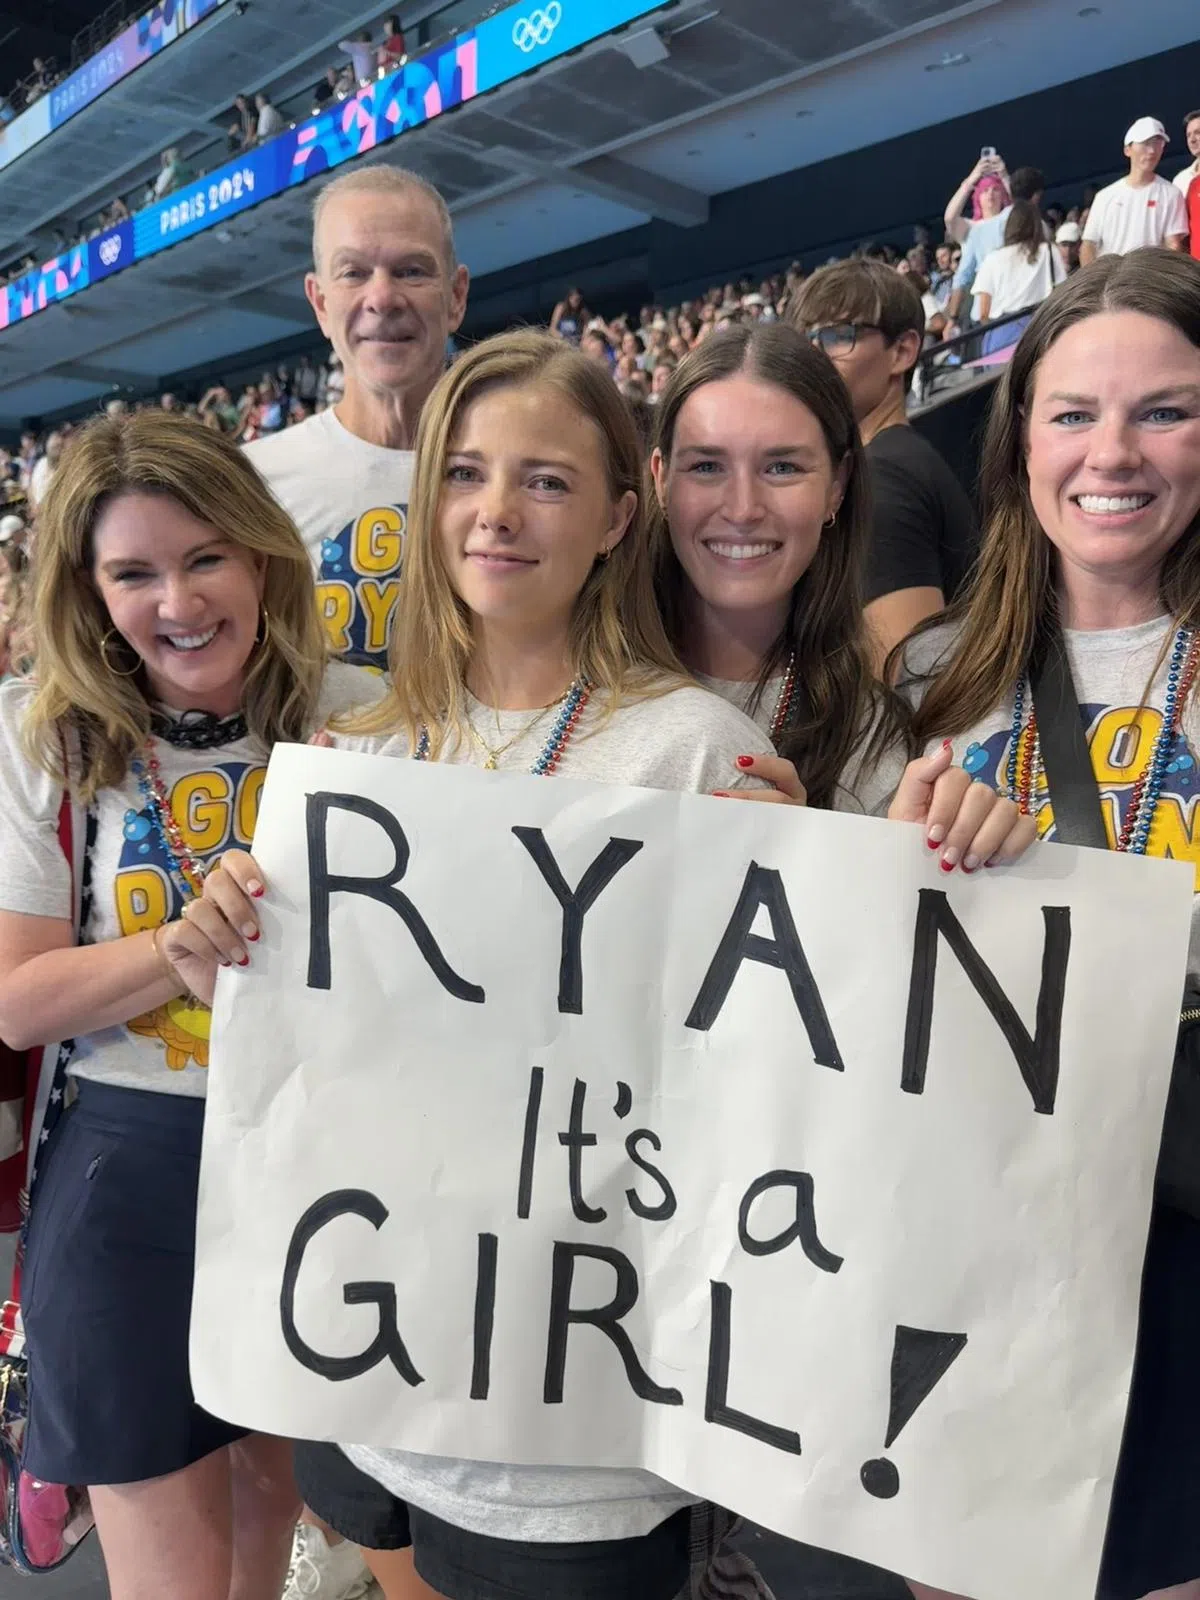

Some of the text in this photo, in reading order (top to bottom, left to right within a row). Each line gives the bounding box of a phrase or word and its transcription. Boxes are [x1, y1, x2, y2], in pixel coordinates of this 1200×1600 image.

[160, 167, 255, 236] PARIS 2024
[305, 792, 1072, 1115] RYAN
[517, 1066, 844, 1273] It's a
